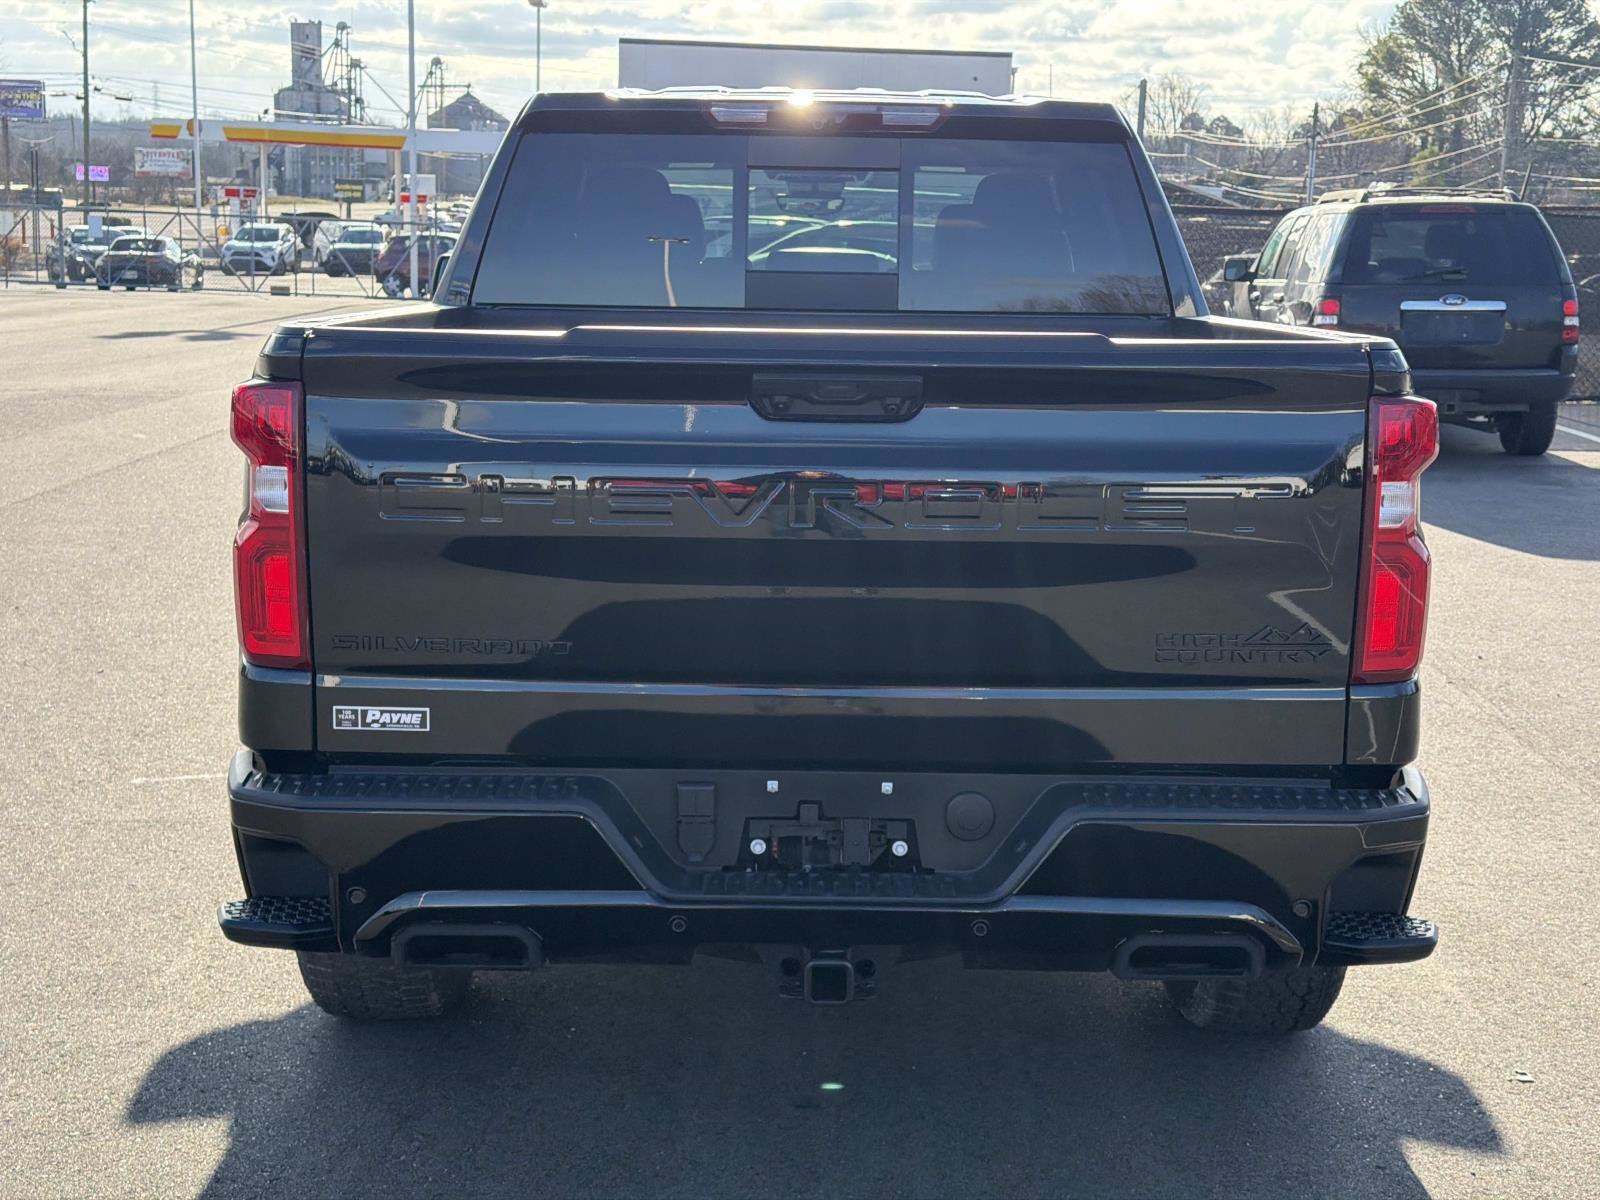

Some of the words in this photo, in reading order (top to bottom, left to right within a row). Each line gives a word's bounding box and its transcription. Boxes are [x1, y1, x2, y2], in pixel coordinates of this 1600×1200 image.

[378, 471, 1294, 533] CHEVROLET
[332, 635, 573, 655] SILVERADO
[1155, 633, 1247, 648] HIGH
[1154, 648, 1330, 664] COUNTRY
[365, 709, 422, 724] PAYNE
